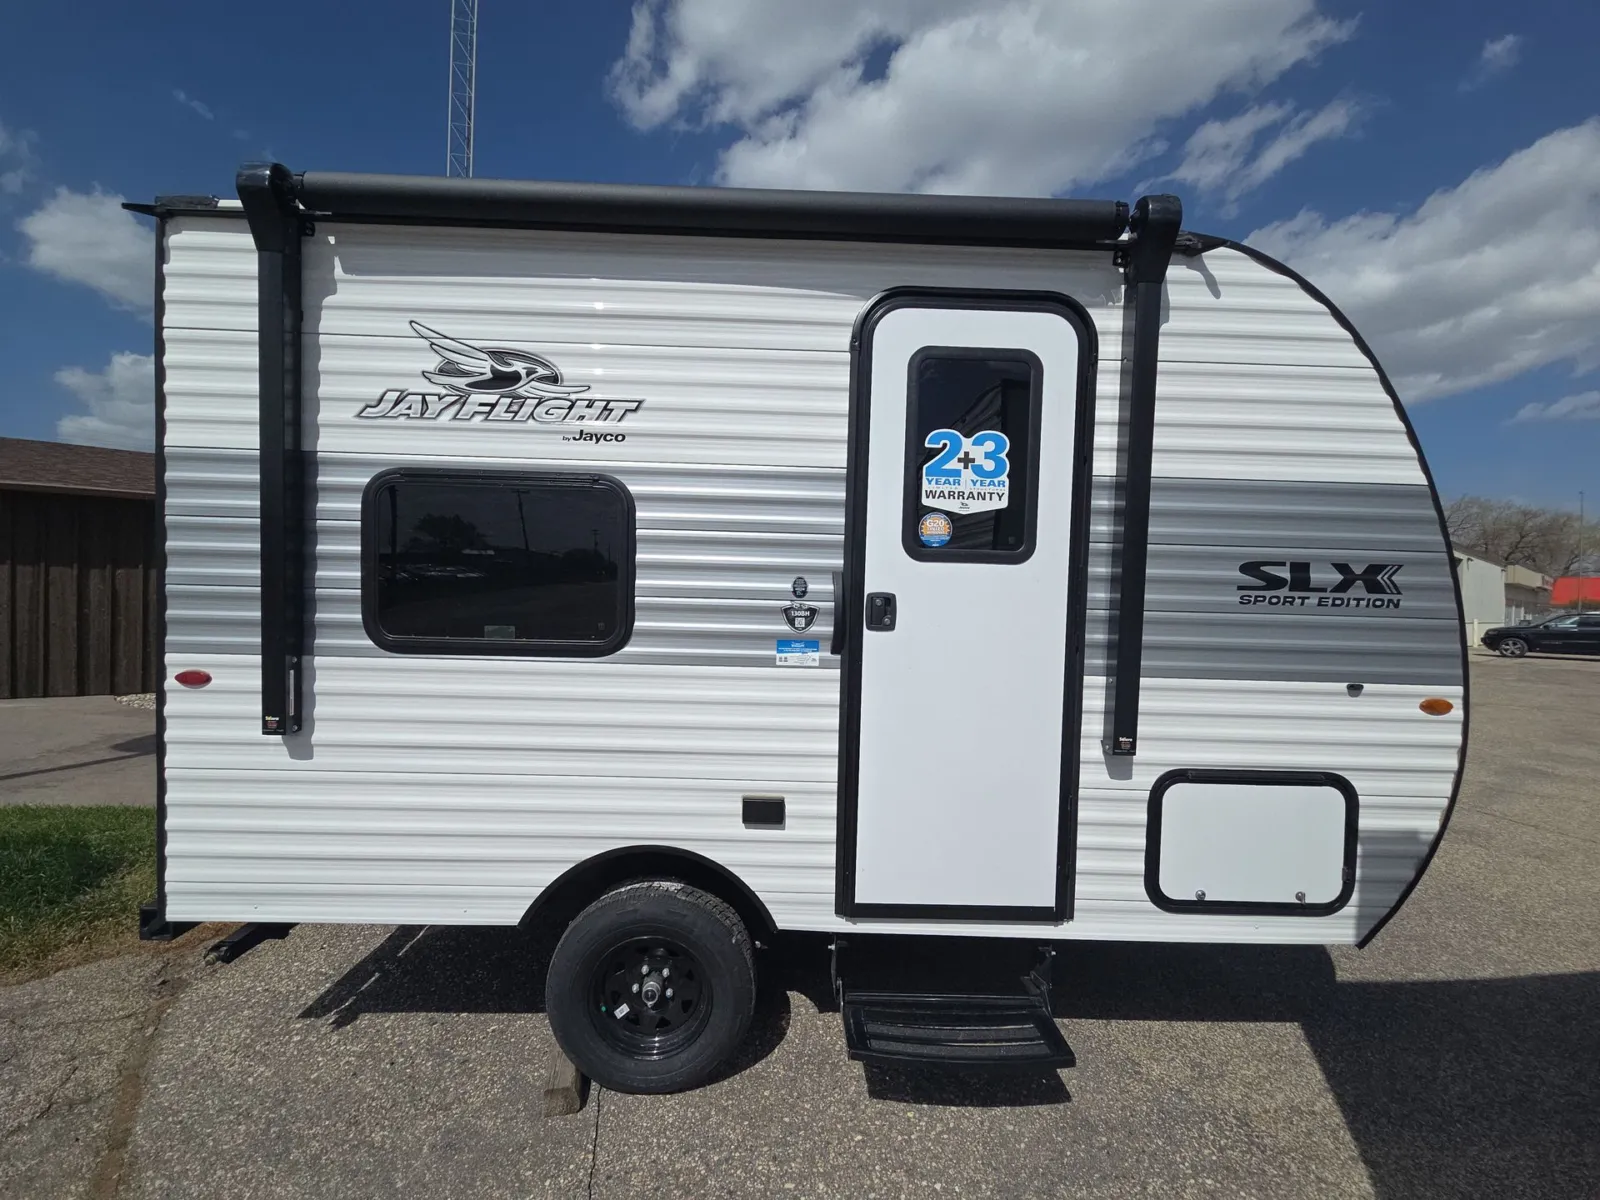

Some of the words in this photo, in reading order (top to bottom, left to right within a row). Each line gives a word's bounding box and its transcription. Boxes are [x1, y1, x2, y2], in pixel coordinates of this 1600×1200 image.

[355, 388, 466, 420] JAY
[453, 393, 646, 424] FLIGHT
[572, 429, 626, 444] Jayco
[926, 478, 961, 486] YEAR
[970, 479, 1006, 488] YEAR
[925, 490, 1005, 501] WARRANTY
[1236, 560, 1404, 595] SLX
[1238, 594, 1310, 607] SPORT
[1316, 596, 1402, 609] EDITION
